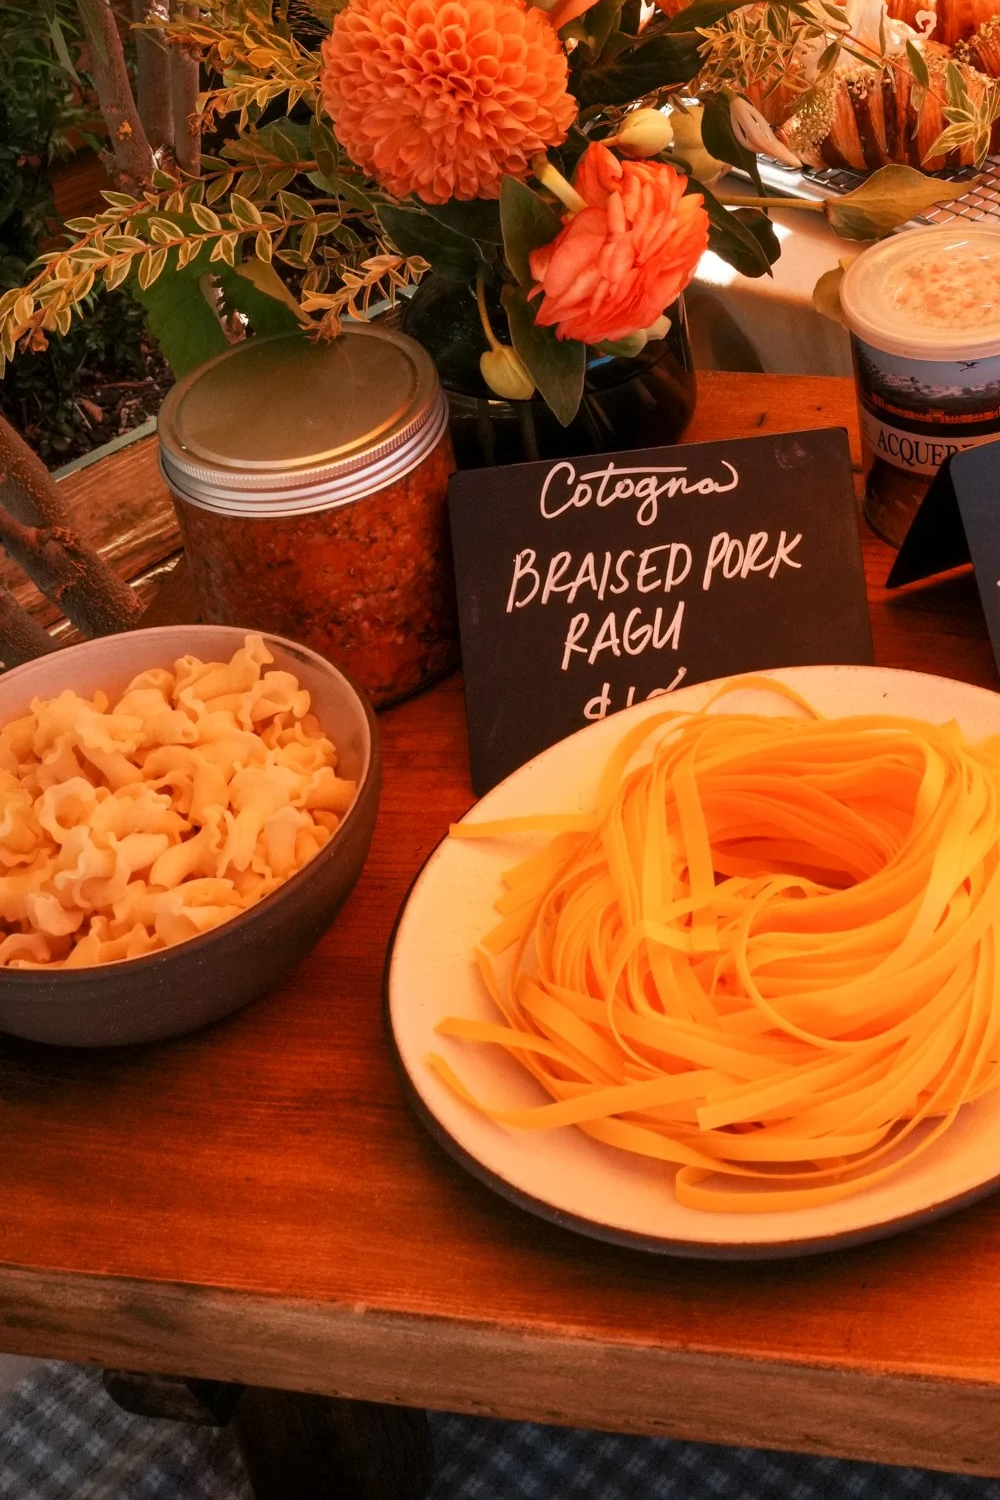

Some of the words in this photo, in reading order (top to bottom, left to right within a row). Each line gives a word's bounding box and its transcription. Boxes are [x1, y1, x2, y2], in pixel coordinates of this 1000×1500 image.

[540, 460, 739, 526] Cotogna
[506, 542, 692, 613] BRAISED
[702, 530, 802, 591] PORK
[561, 600, 685, 671] RAGU
